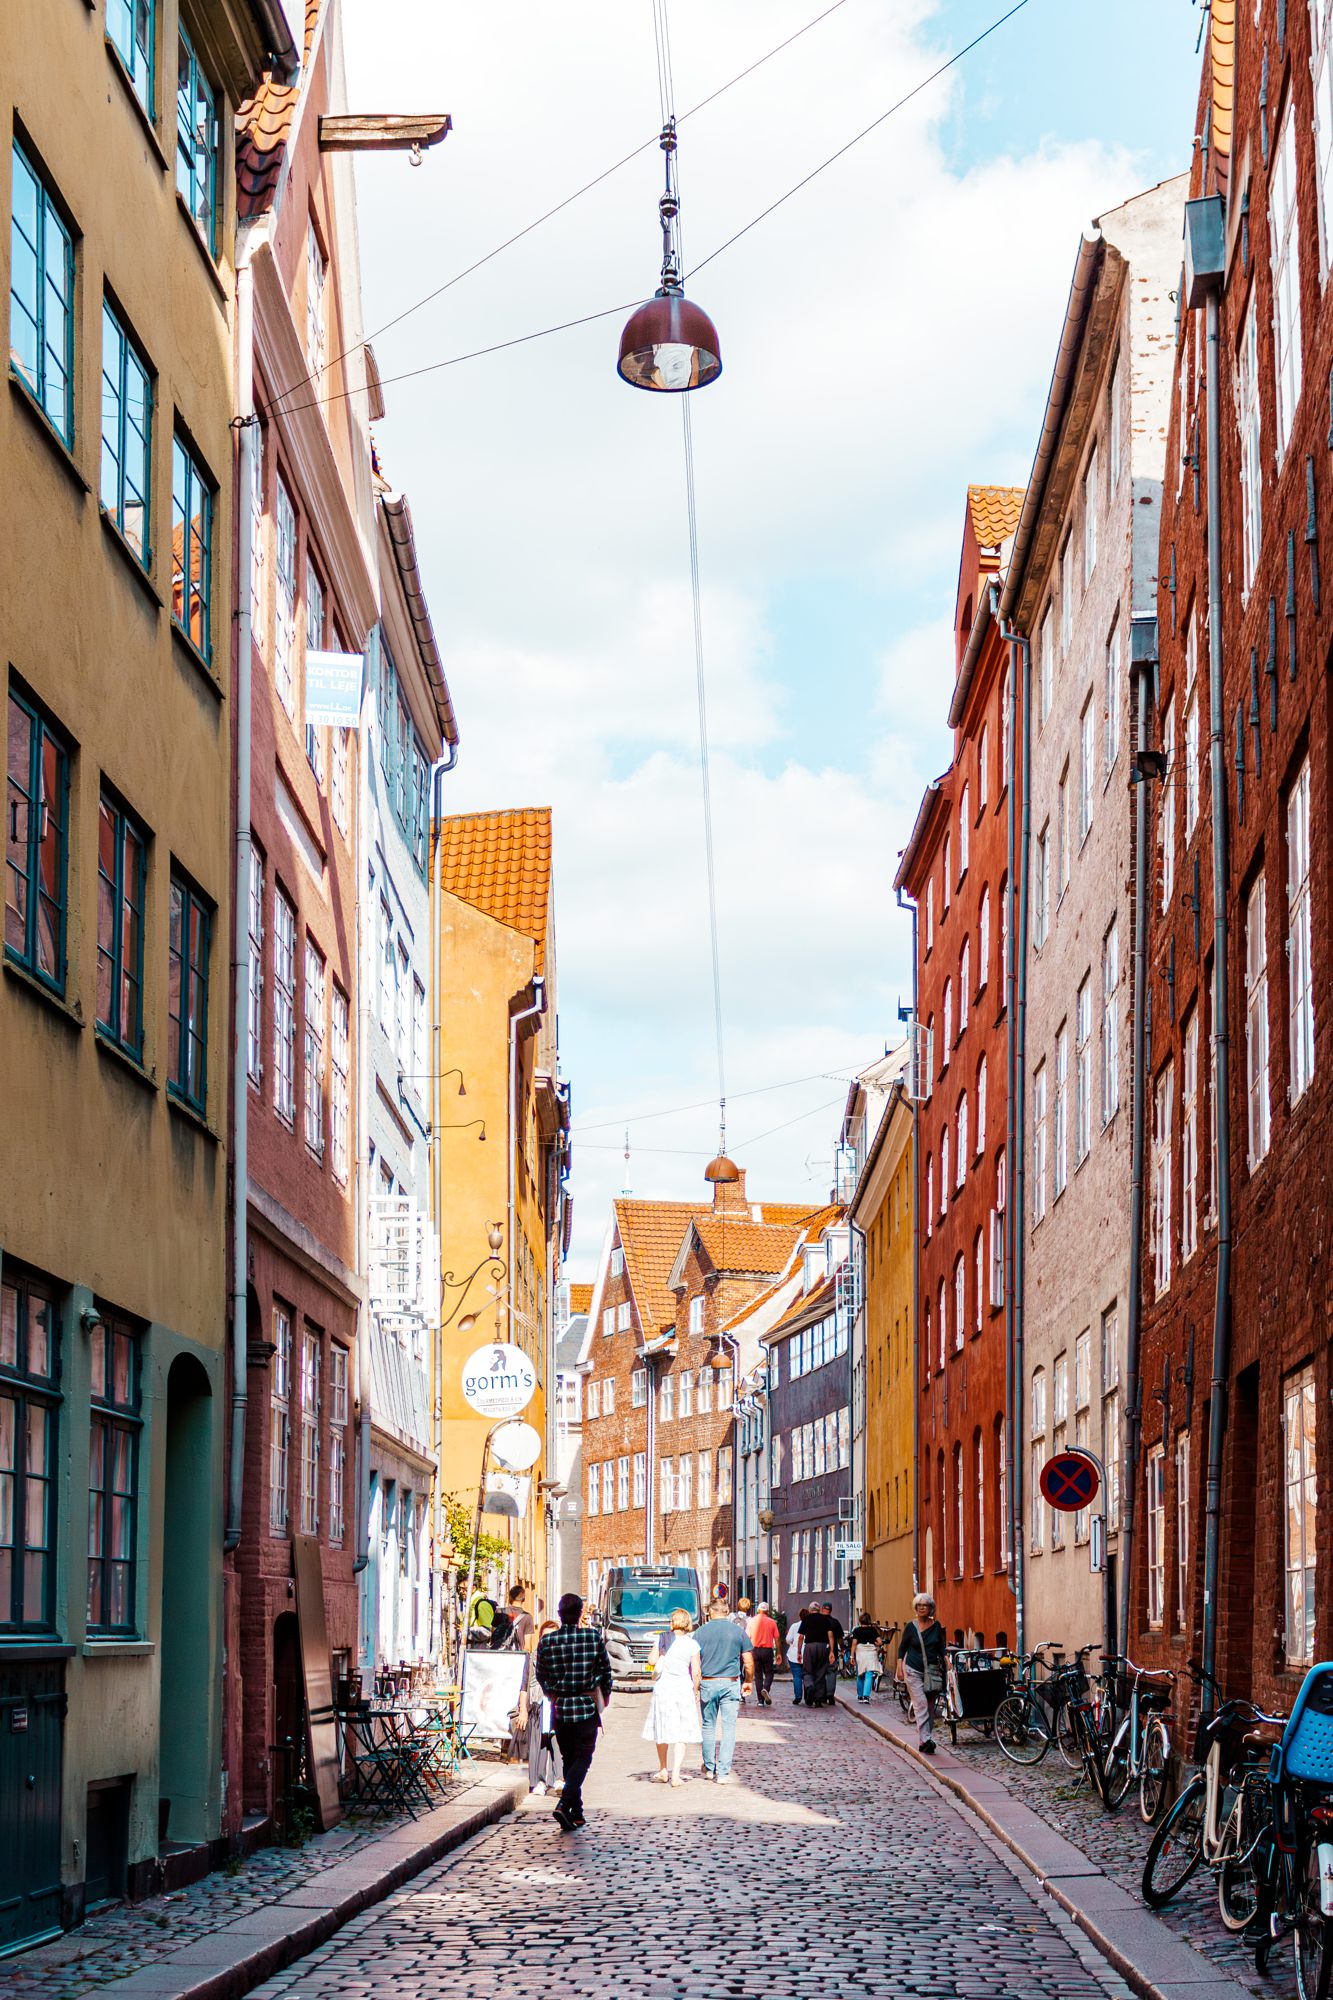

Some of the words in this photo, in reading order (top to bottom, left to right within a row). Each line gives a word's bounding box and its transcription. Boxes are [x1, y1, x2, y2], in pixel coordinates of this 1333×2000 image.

[308, 667, 357, 679] KONTOR
[307, 679, 326, 689] TIL
[331, 681, 357, 692] LEJE
[465, 1368, 533, 1397] gorm's
